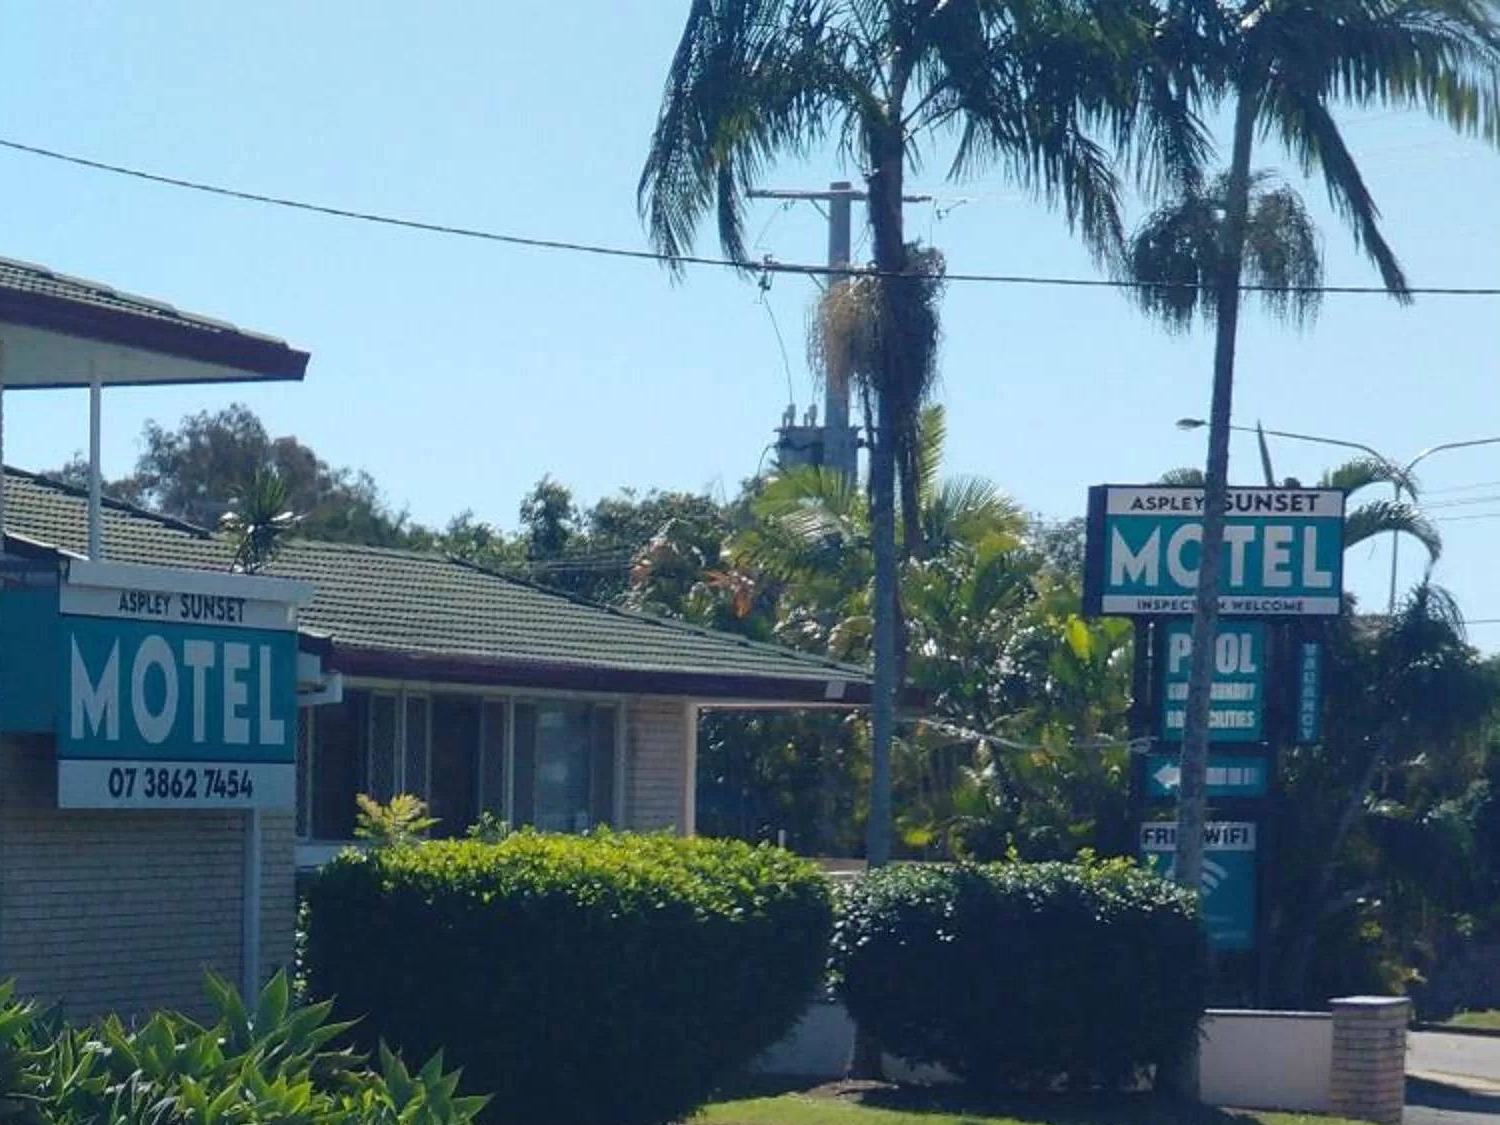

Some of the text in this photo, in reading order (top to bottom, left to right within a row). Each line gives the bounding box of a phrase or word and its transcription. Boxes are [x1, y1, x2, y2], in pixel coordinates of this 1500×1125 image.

[1131, 493, 1320, 513] ASPLEY SUNSET
[1110, 523, 1332, 588] MOTEL
[118, 591, 246, 623] ASPLEY SUNSET
[1232, 600, 1305, 611] WELCOME
[1169, 633, 1256, 673] POL
[71, 632, 285, 745] MOTEL
[108, 767, 253, 799] 07 3862 7454
